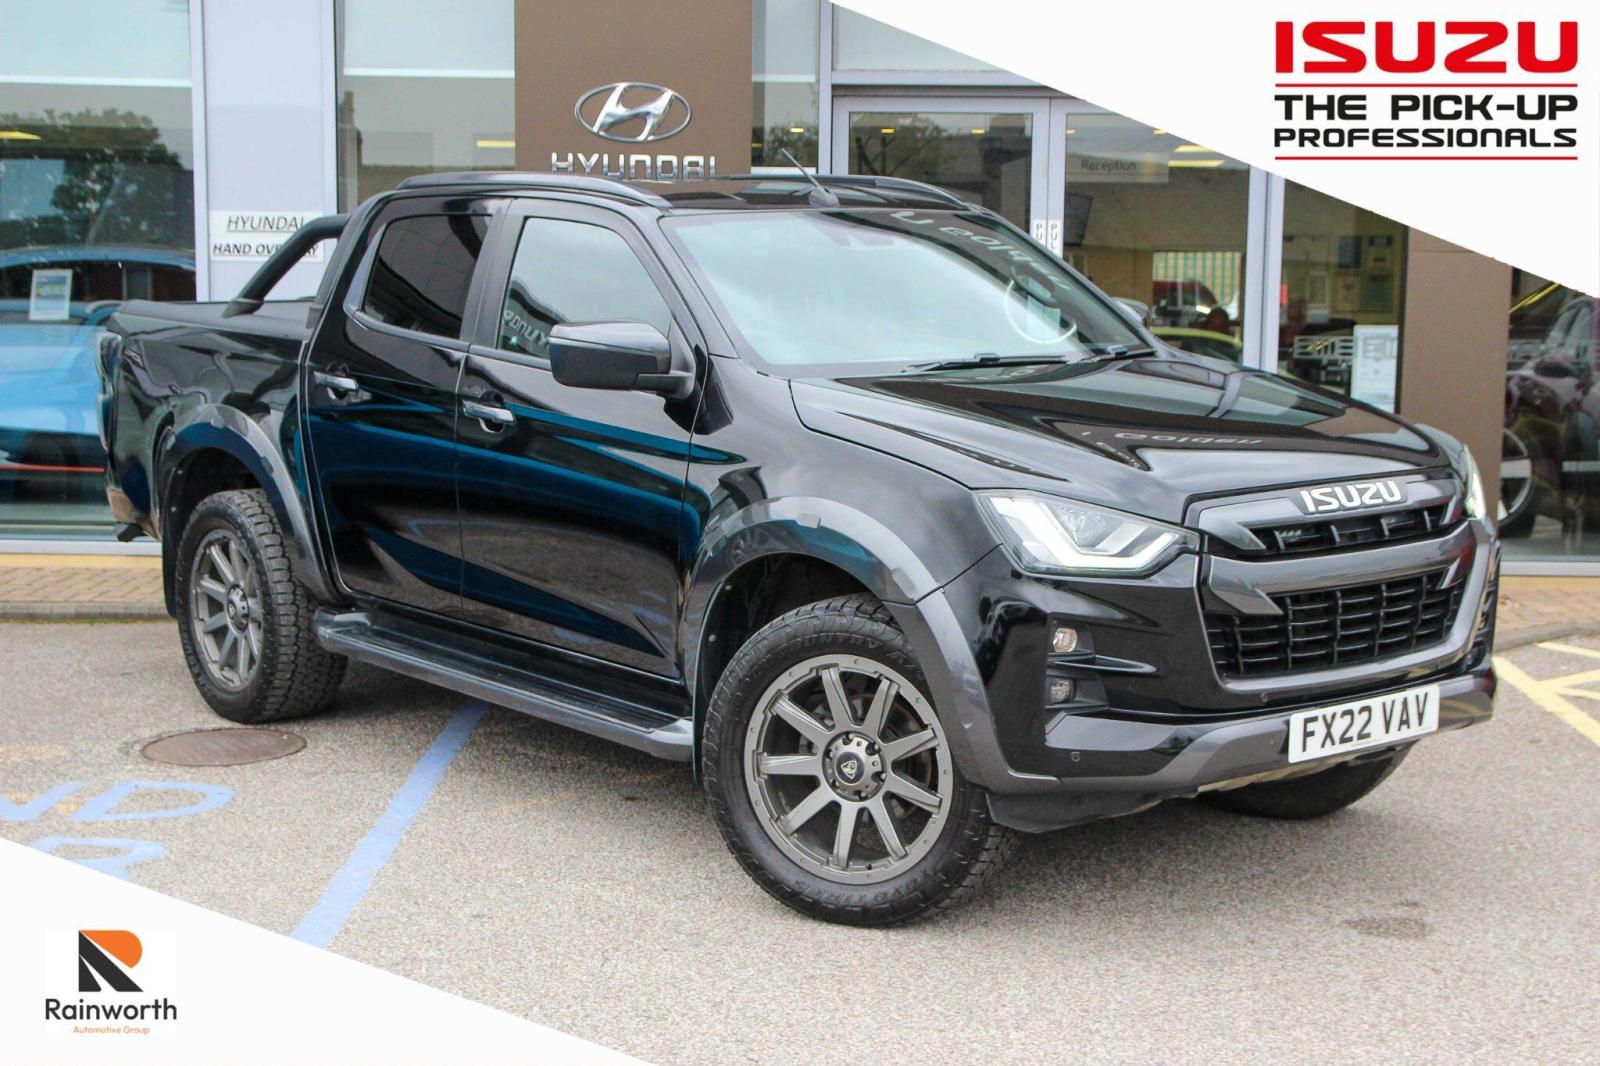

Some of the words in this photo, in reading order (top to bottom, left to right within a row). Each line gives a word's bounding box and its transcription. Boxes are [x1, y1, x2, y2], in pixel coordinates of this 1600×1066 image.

[551, 152, 717, 182] HYUNDAI
[1081, 158, 1137, 172] Reception
[1035, 222, 1043, 240] PU
[1050, 223, 1058, 249] PUL
[212, 243, 251, 256] HAND
[1300, 480, 1401, 513] ISUZU
[1302, 704, 1373, 753] FX22
[1382, 692, 1429, 735] VAV
